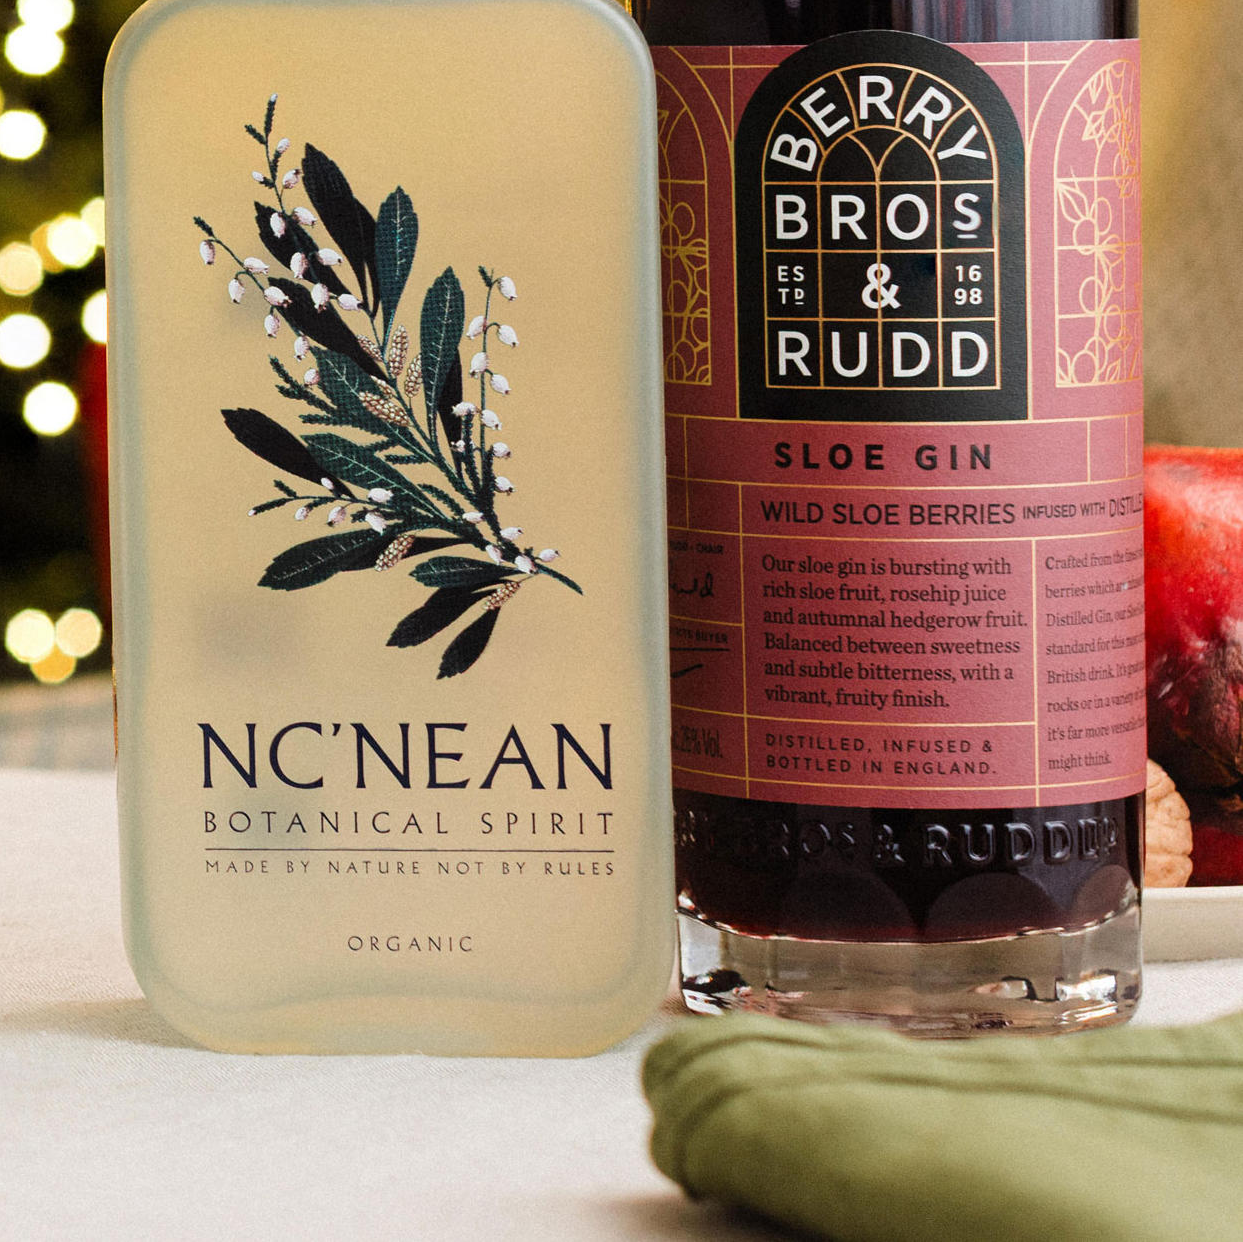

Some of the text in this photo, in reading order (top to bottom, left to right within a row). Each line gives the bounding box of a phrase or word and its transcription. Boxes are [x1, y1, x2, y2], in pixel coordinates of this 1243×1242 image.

[769, 74, 988, 173] BERRY
[774, 192, 982, 241] BROS
[861, 262, 901, 309] &
[778, 330, 989, 378] RUDD
[774, 442, 992, 471] SLOE GIN
[760, 500, 1105, 526] WILD SLOE BERRIES INFUSED WITH
[762, 554, 1011, 579] Our sloe gin is bursting with
[1045, 553, 1089, 570] Crafted
[762, 580, 1006, 606] rich sloe fruit, rosehip juice
[1045, 583, 1086, 598] berries
[763, 607, 1027, 633] and autumnal hedgerow fruit.
[1046, 610, 1093, 627] Distilled
[764, 632, 1020, 655] Balanced between sweetness
[1046, 638, 1096, 655] standard
[764, 659, 1014, 682] and subtle bitterness, with a
[1046, 667, 1086, 684] British
[764, 684, 949, 711] vibrant, fruity finish.
[1047, 697, 1079, 713] rocks
[766, 732, 992, 754] DISTILLED, INFUSED &
[1048, 727, 1065, 741] it's
[766, 754, 995, 775] BOTTLED IN ENGLAND.
[1048, 754, 1082, 772] might
[205, 811, 613, 835] BOTANICAL SPIRIT
[206, 860, 613, 875] MADE BY NATURE NOT BY RULES
[348, 936, 472, 952] ORGANIC
